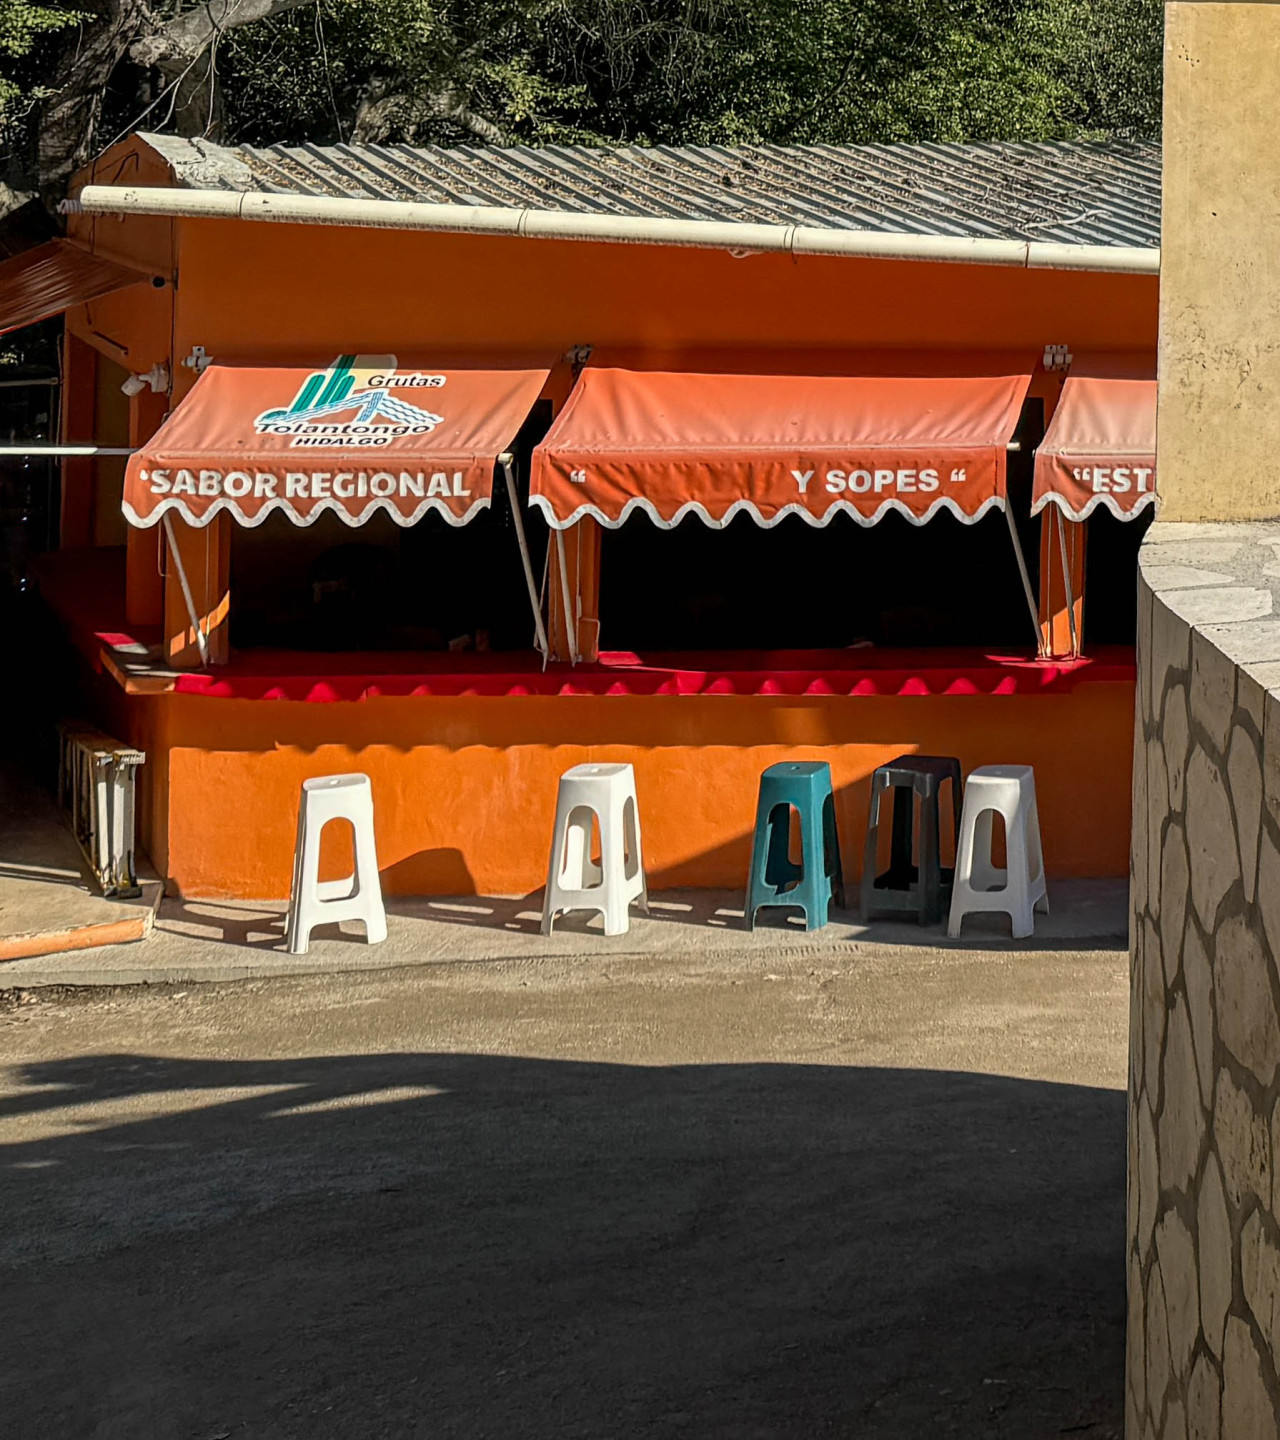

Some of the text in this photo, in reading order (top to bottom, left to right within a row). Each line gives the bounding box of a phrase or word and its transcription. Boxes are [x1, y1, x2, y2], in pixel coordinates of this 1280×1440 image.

[367, 374, 443, 388] Grutas
[257, 423, 431, 436] Tolantongo
[295, 437, 388, 446] HIDALGO
[285, 471, 471, 498] REGIONAL
[790, 468, 940, 494] Y SOPES
